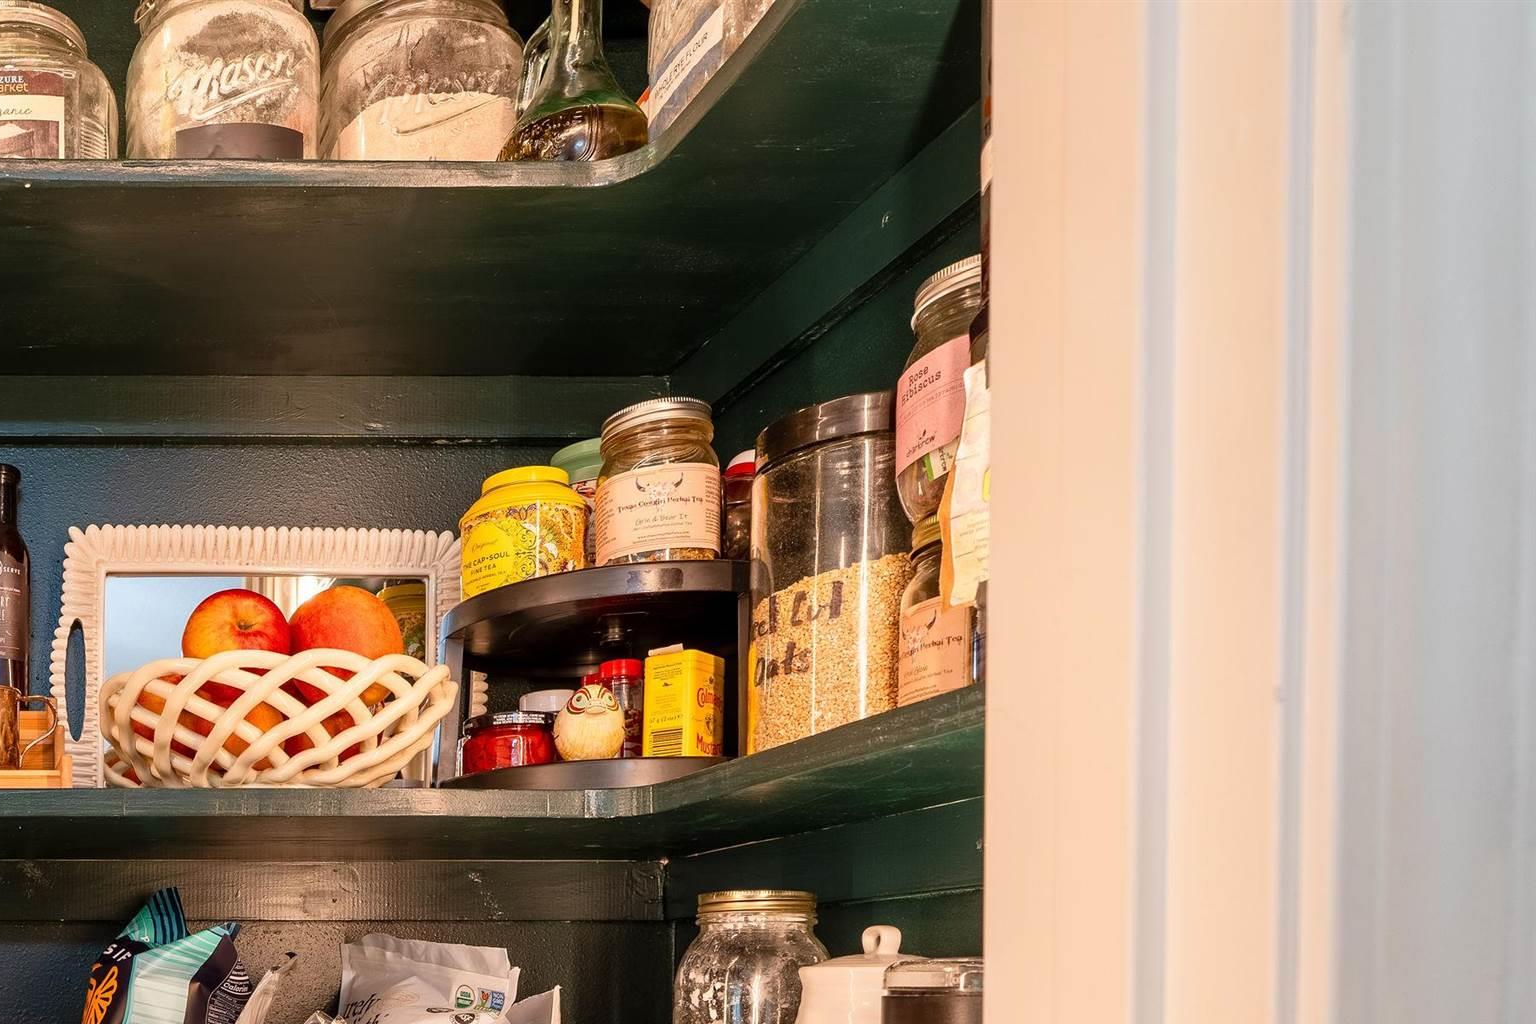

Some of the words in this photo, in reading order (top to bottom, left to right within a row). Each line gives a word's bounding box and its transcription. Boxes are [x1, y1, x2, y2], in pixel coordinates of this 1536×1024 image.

[907, 366, 929, 388] Rose
[692, 495, 704, 503] Tea
[483, 563, 497, 572] TEA
[946, 635, 963, 646] Tea
[754, 640, 813, 688] Oats
